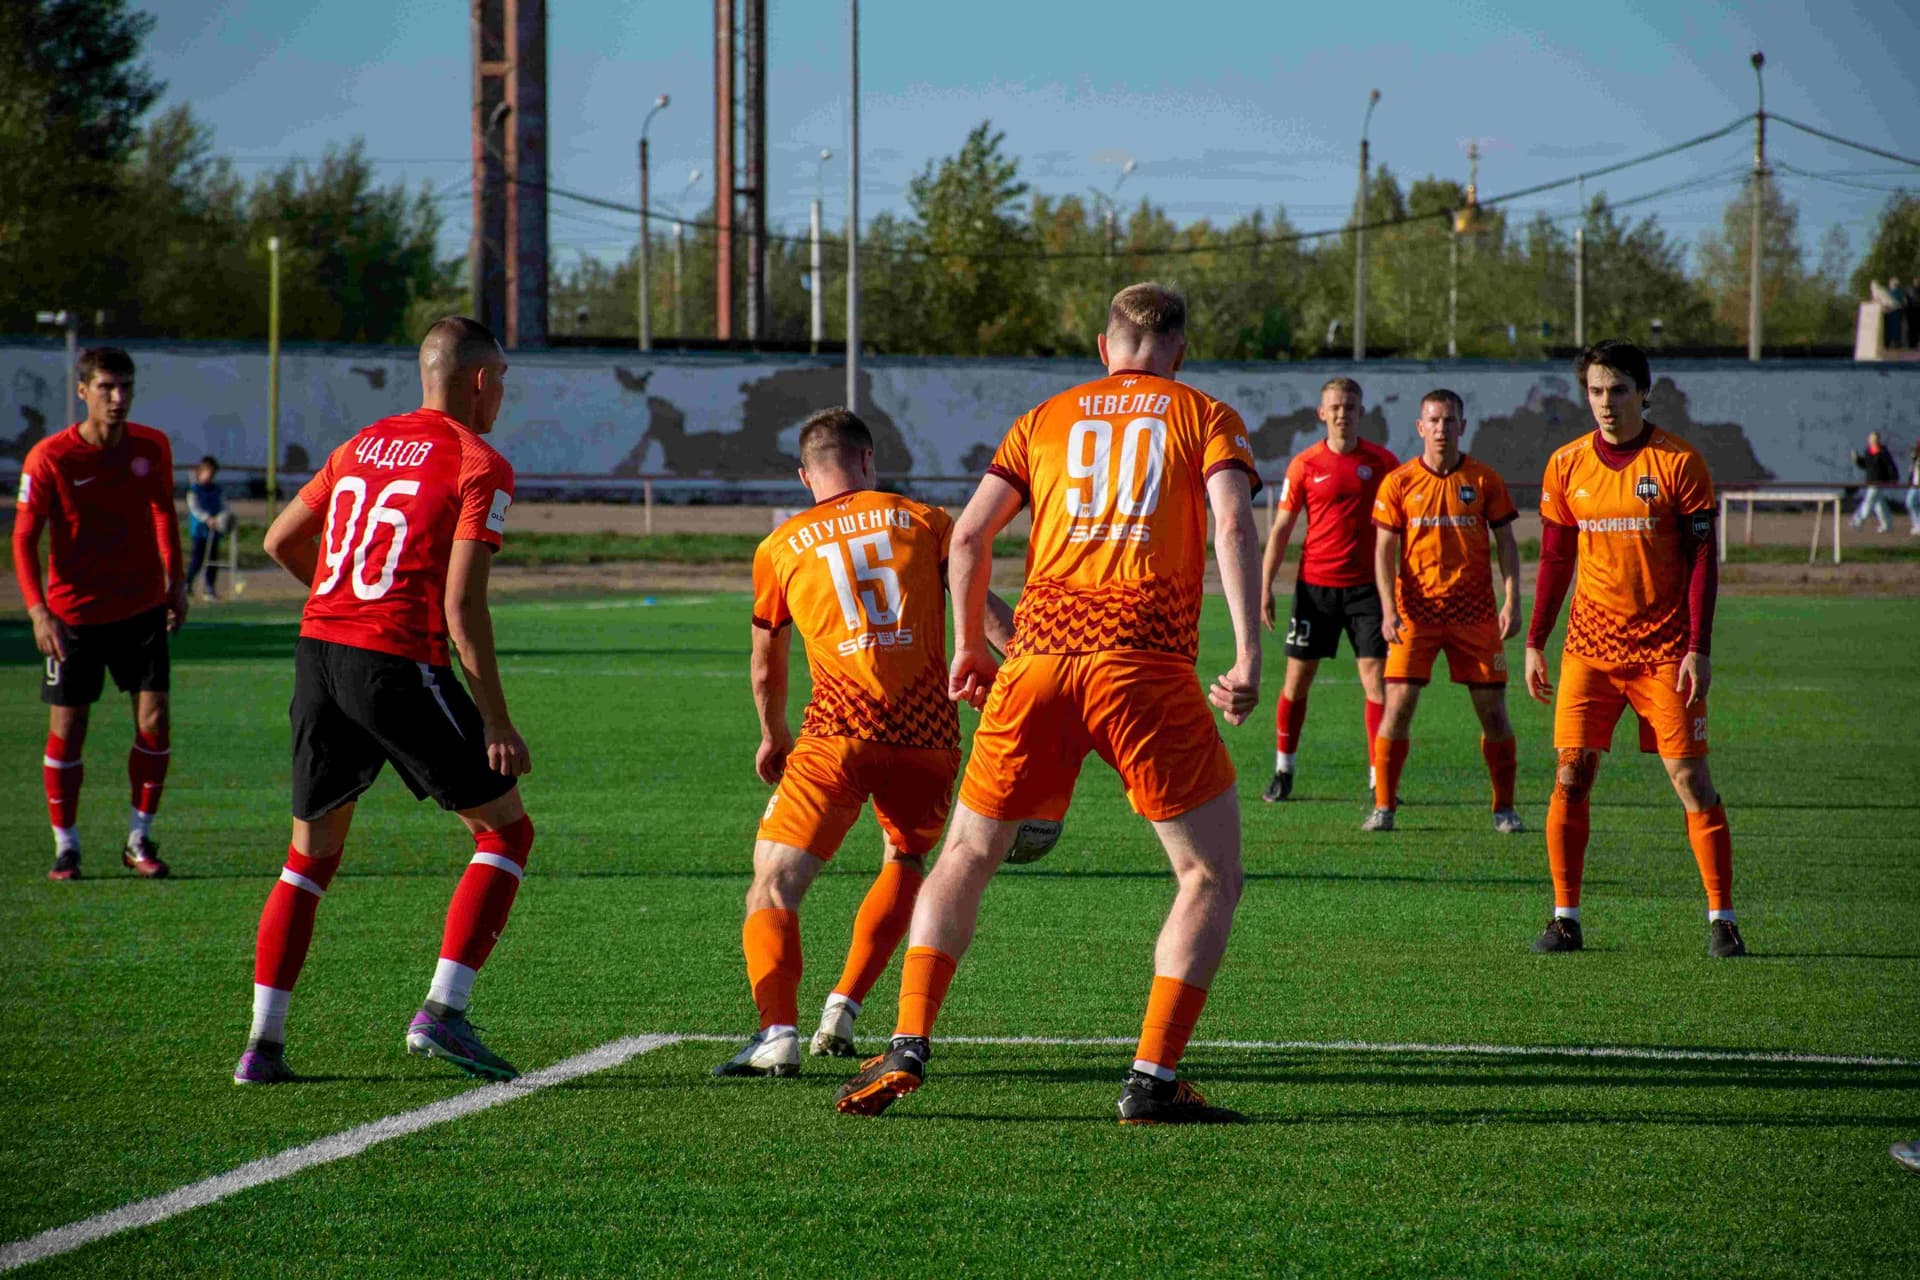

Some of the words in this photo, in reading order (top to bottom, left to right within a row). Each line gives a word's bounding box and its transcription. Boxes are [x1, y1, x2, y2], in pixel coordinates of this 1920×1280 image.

[1078, 393, 1171, 416] ЧЕВЕЛЕВ
[355, 436, 433, 470] ЧАДОВ
[1066, 417, 1167, 518] 90
[315, 476, 421, 600] 96
[788, 508, 911, 555] ЕВТУШЕНКО
[815, 530, 901, 631] 15
[1286, 617, 1311, 646] 22
